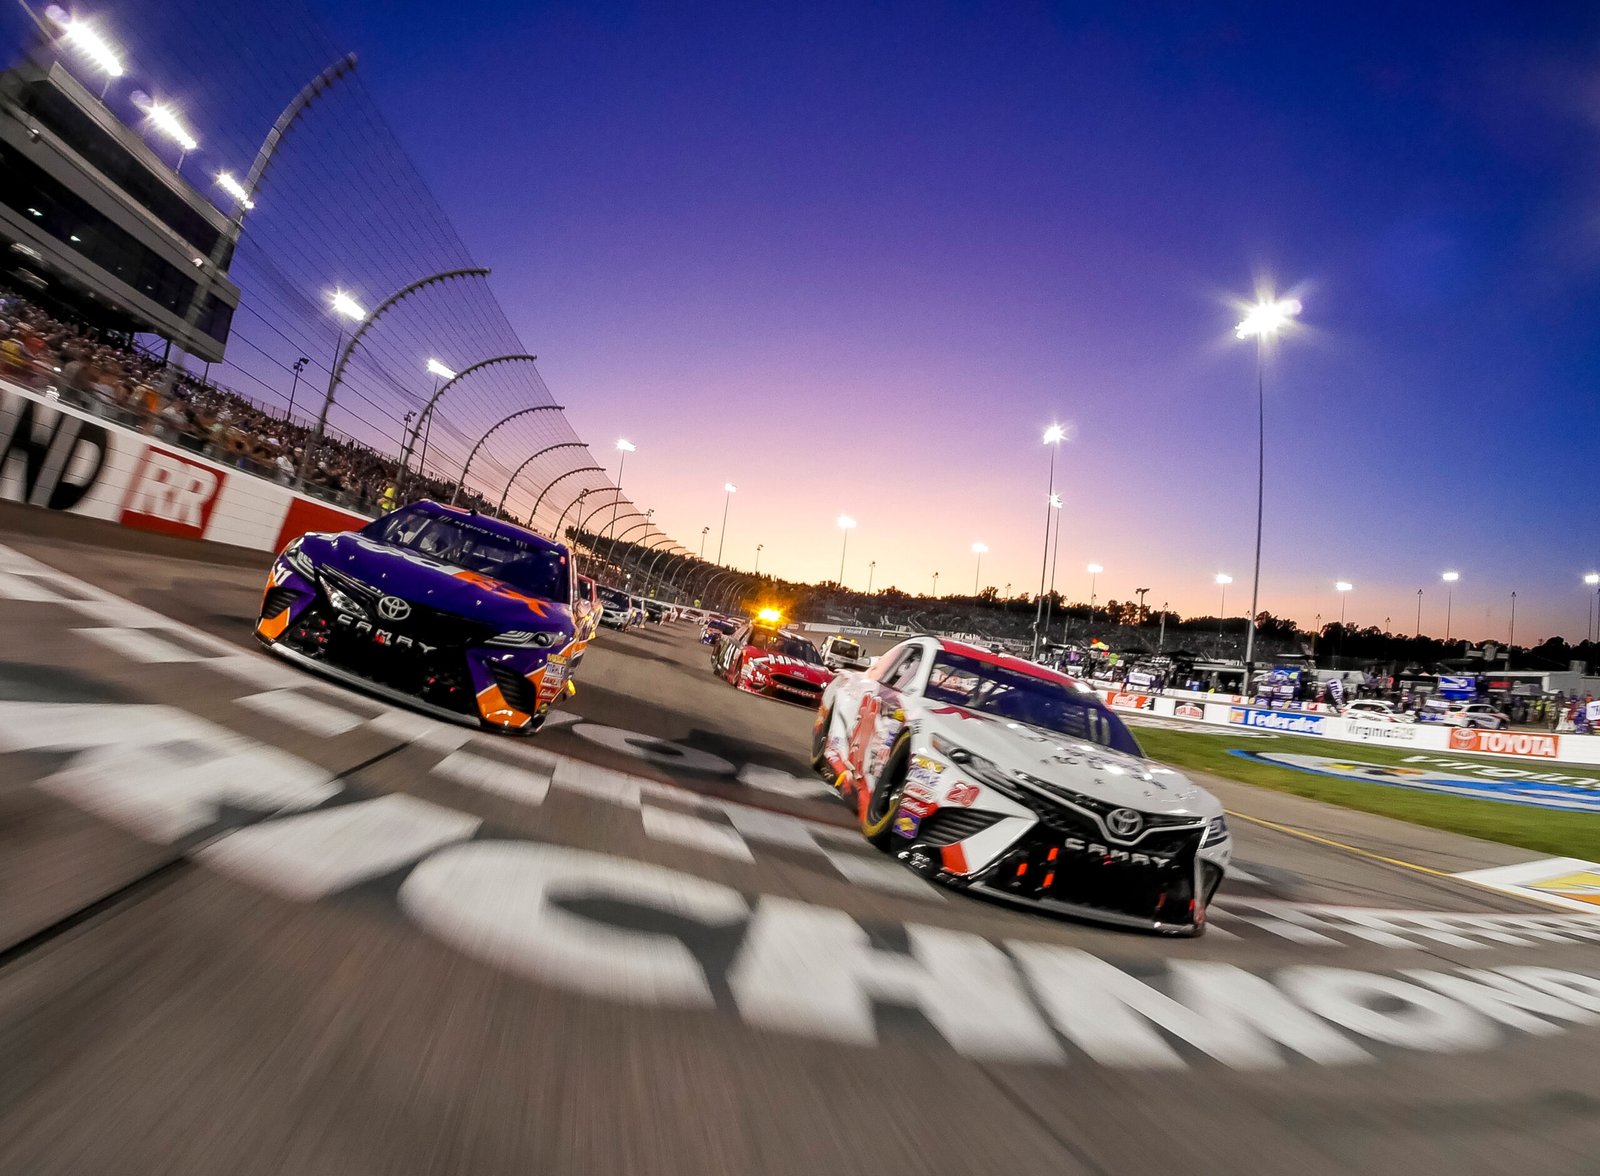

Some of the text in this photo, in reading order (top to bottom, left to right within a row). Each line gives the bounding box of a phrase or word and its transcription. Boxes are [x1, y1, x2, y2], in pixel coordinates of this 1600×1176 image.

[132, 450, 218, 528] RR
[337, 613, 437, 653] CAMRY
[1247, 711, 1326, 735] Federated
[1478, 732, 1557, 757] TOYOTA
[1064, 837, 1170, 868] CAMRY
